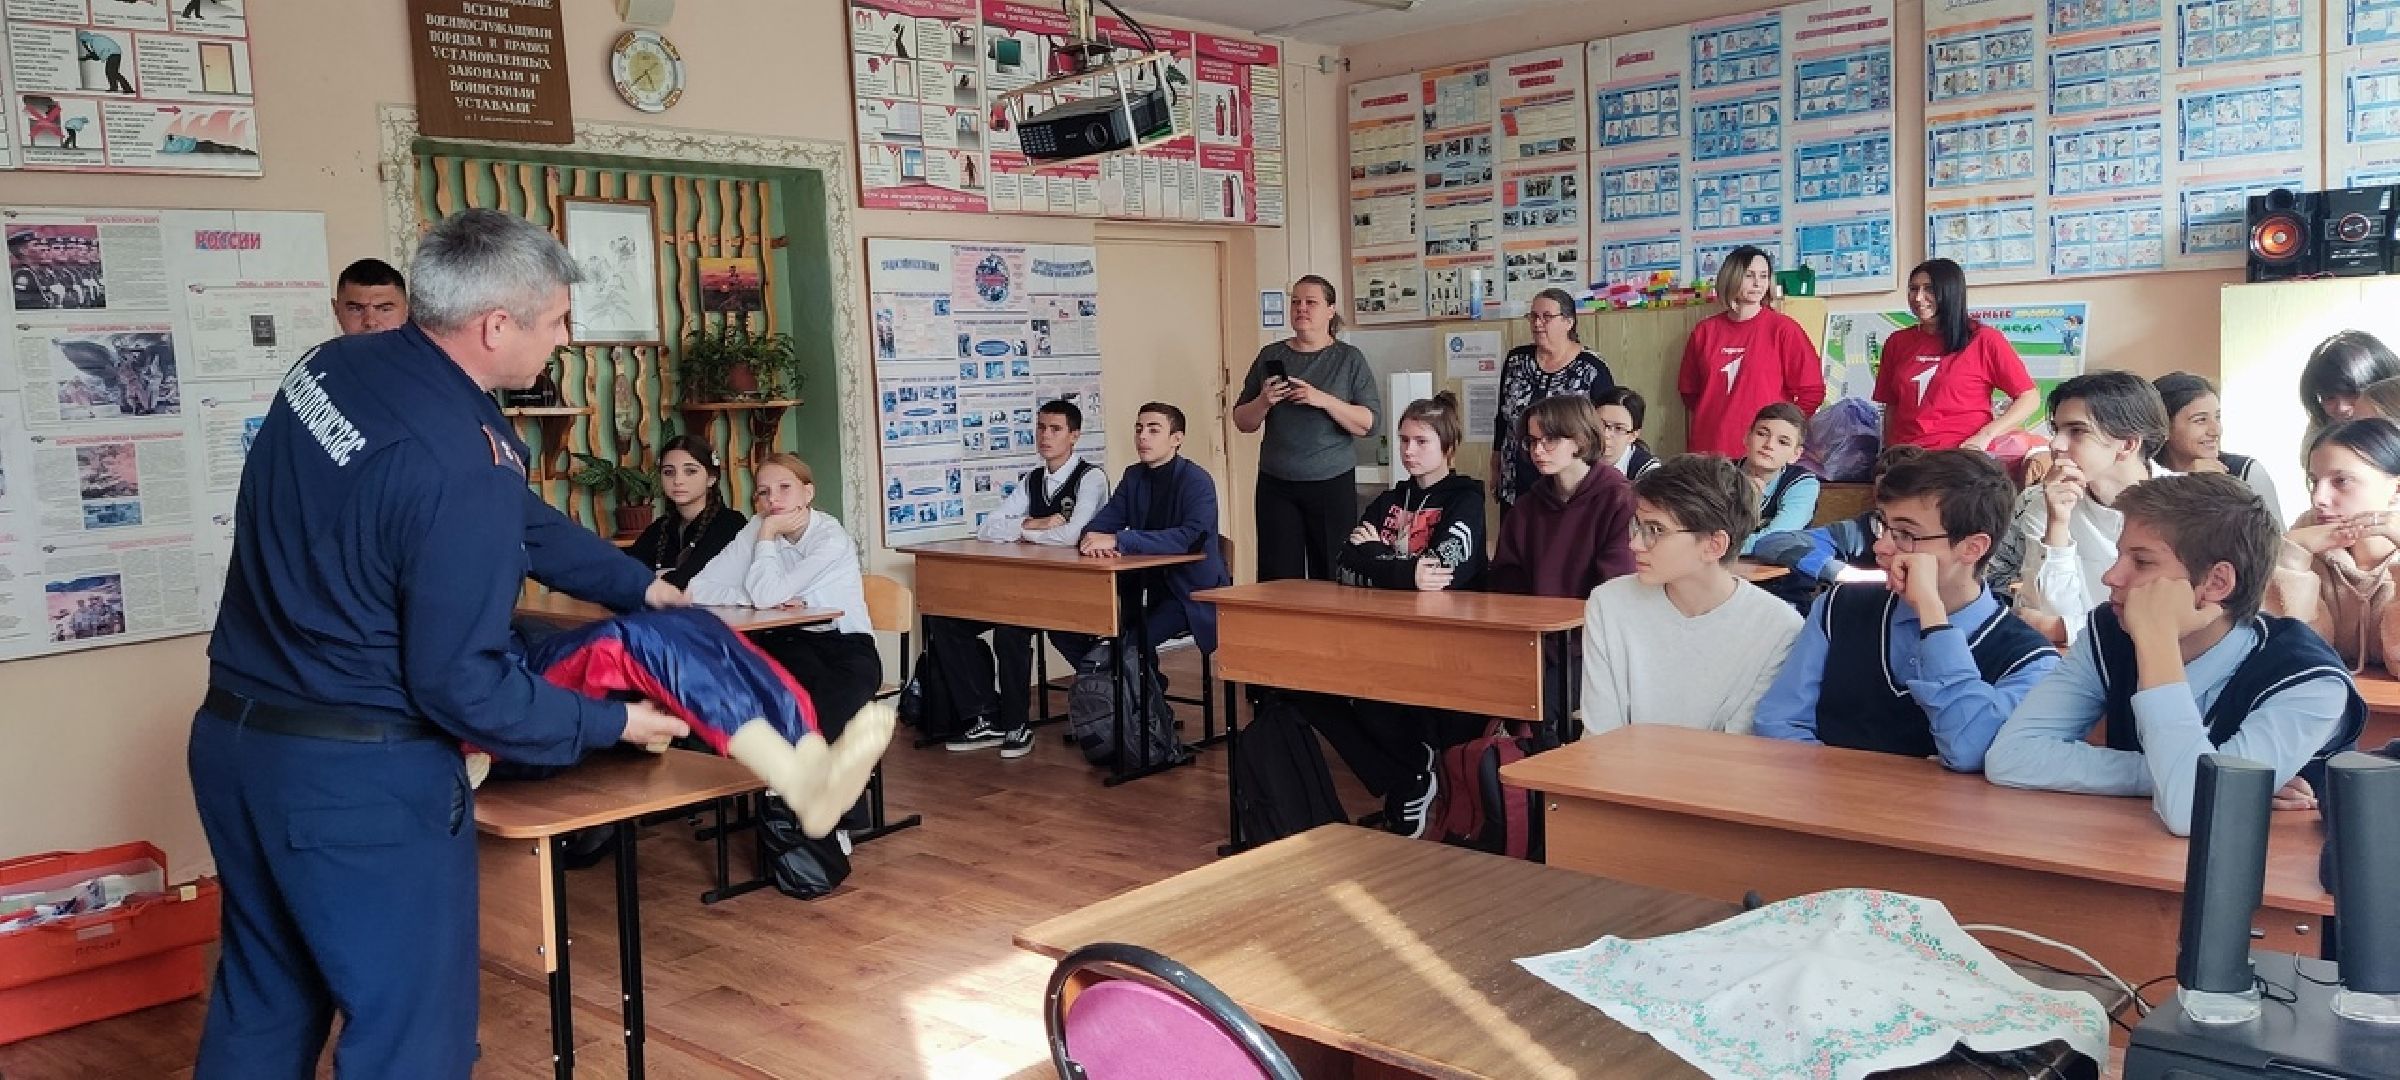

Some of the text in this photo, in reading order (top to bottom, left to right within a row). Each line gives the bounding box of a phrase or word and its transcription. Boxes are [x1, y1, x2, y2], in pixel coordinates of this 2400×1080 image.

[462, 2, 510, 19] ВСЕМИ
[425, 13, 552, 40] ВОЕННОСЛУЖАЩИМИ
[504, 38, 550, 55] ПРАВИЛ
[431, 45, 552, 70] УСТАНОВЛЕННЫХ
[448, 64, 541, 85] ЗАКОНАМИ И
[450, 79, 536, 100] ВОИНСКИМИ
[195, 230, 261, 249] РОССИИ
